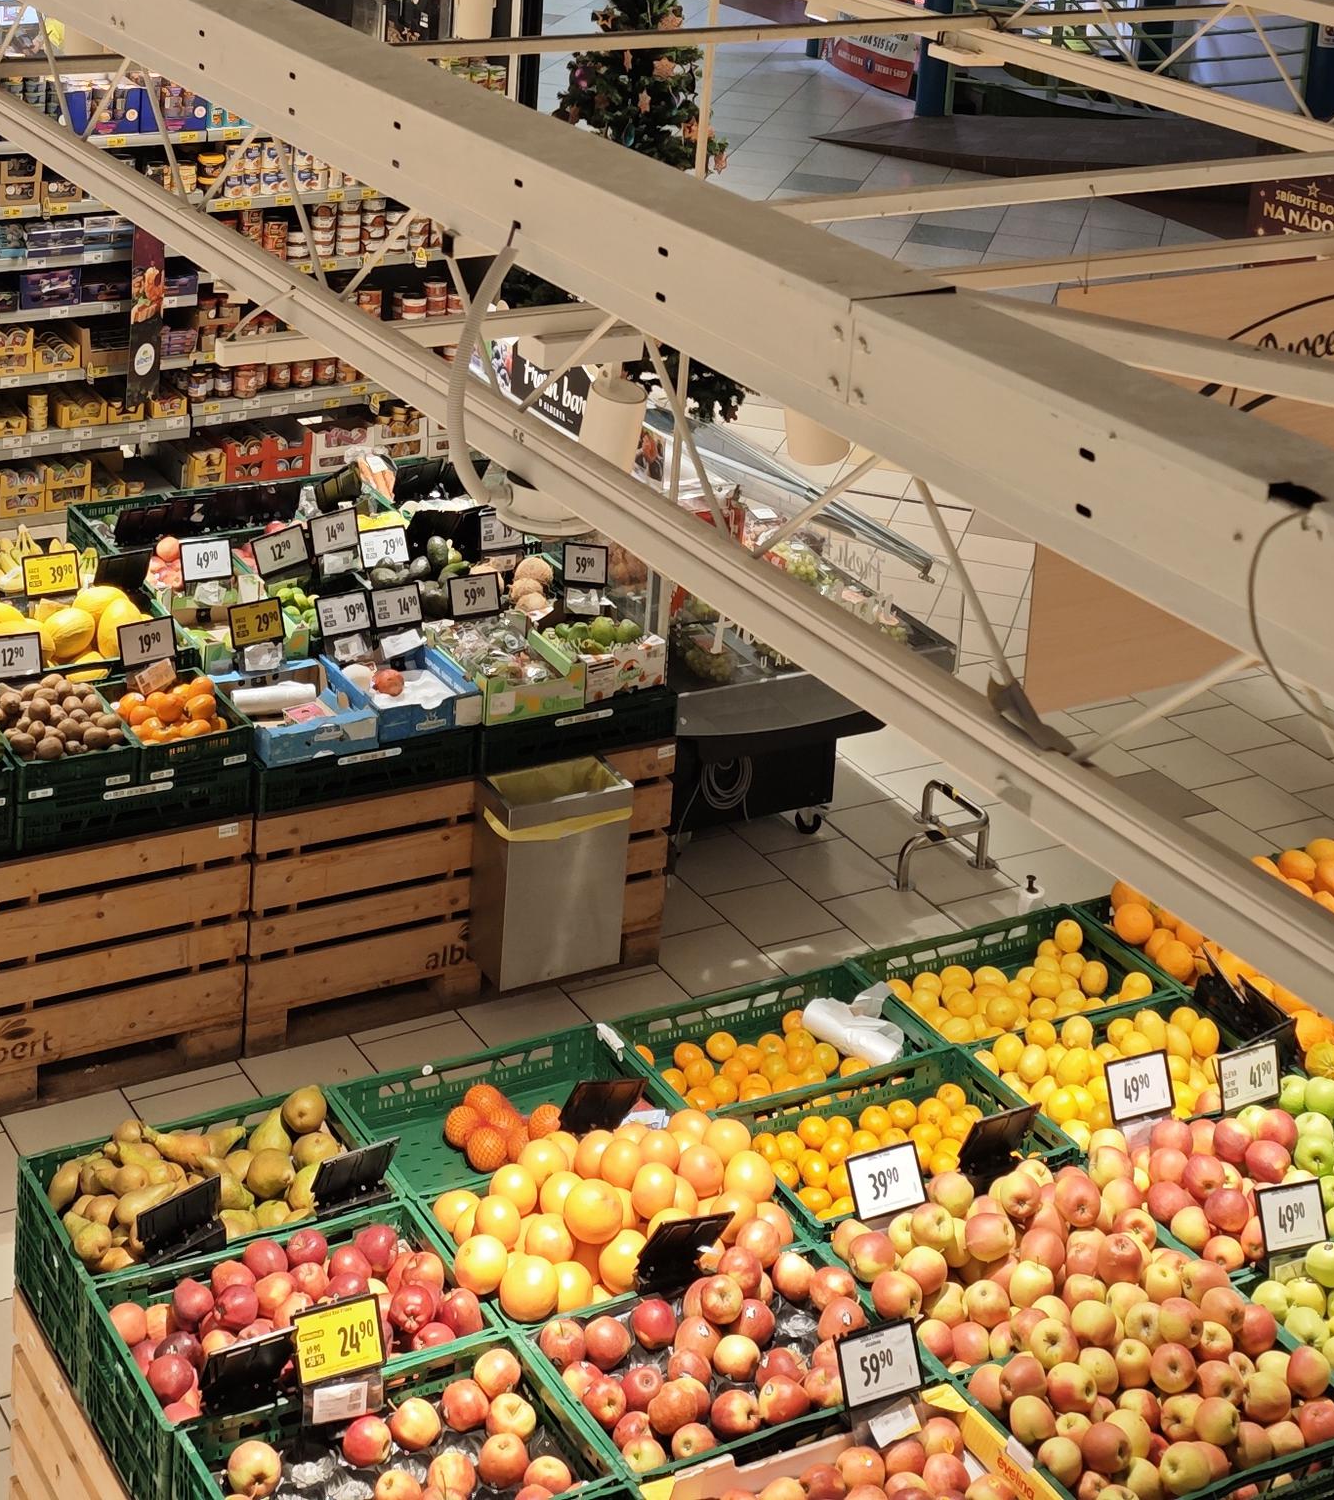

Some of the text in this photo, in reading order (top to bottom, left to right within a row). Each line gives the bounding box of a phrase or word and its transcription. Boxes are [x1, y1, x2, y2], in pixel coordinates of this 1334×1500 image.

[1275, 189, 1318, 211] SBÍREJTE
[1263, 201, 1286, 222] NA
[325, 521, 346, 543] 1490
[269, 538, 292, 562] 1290
[382, 535, 405, 556] 2990
[196, 550, 220, 570] 4990
[575, 555, 596, 575] 5990
[49, 563, 74, 584] 3990
[396, 595, 418, 616] 1490
[464, 586, 486, 608] 5990
[254, 610, 280, 633] 2990
[343, 602, 366, 623] 1990
[137, 631, 161, 654] 1990
[0, 646, 25, 667] 1290
[1249, 1059, 1272, 1089] 4190
[1124, 1072, 1151, 1104] 4990
[867, 1166, 899, 1201] 3990
[1277, 1202, 1306, 1234] 4990
[337, 1319, 375, 1357] 2490
[859, 1348, 894, 1388] 5990
[996, 1454, 1035, 1500] evelina
